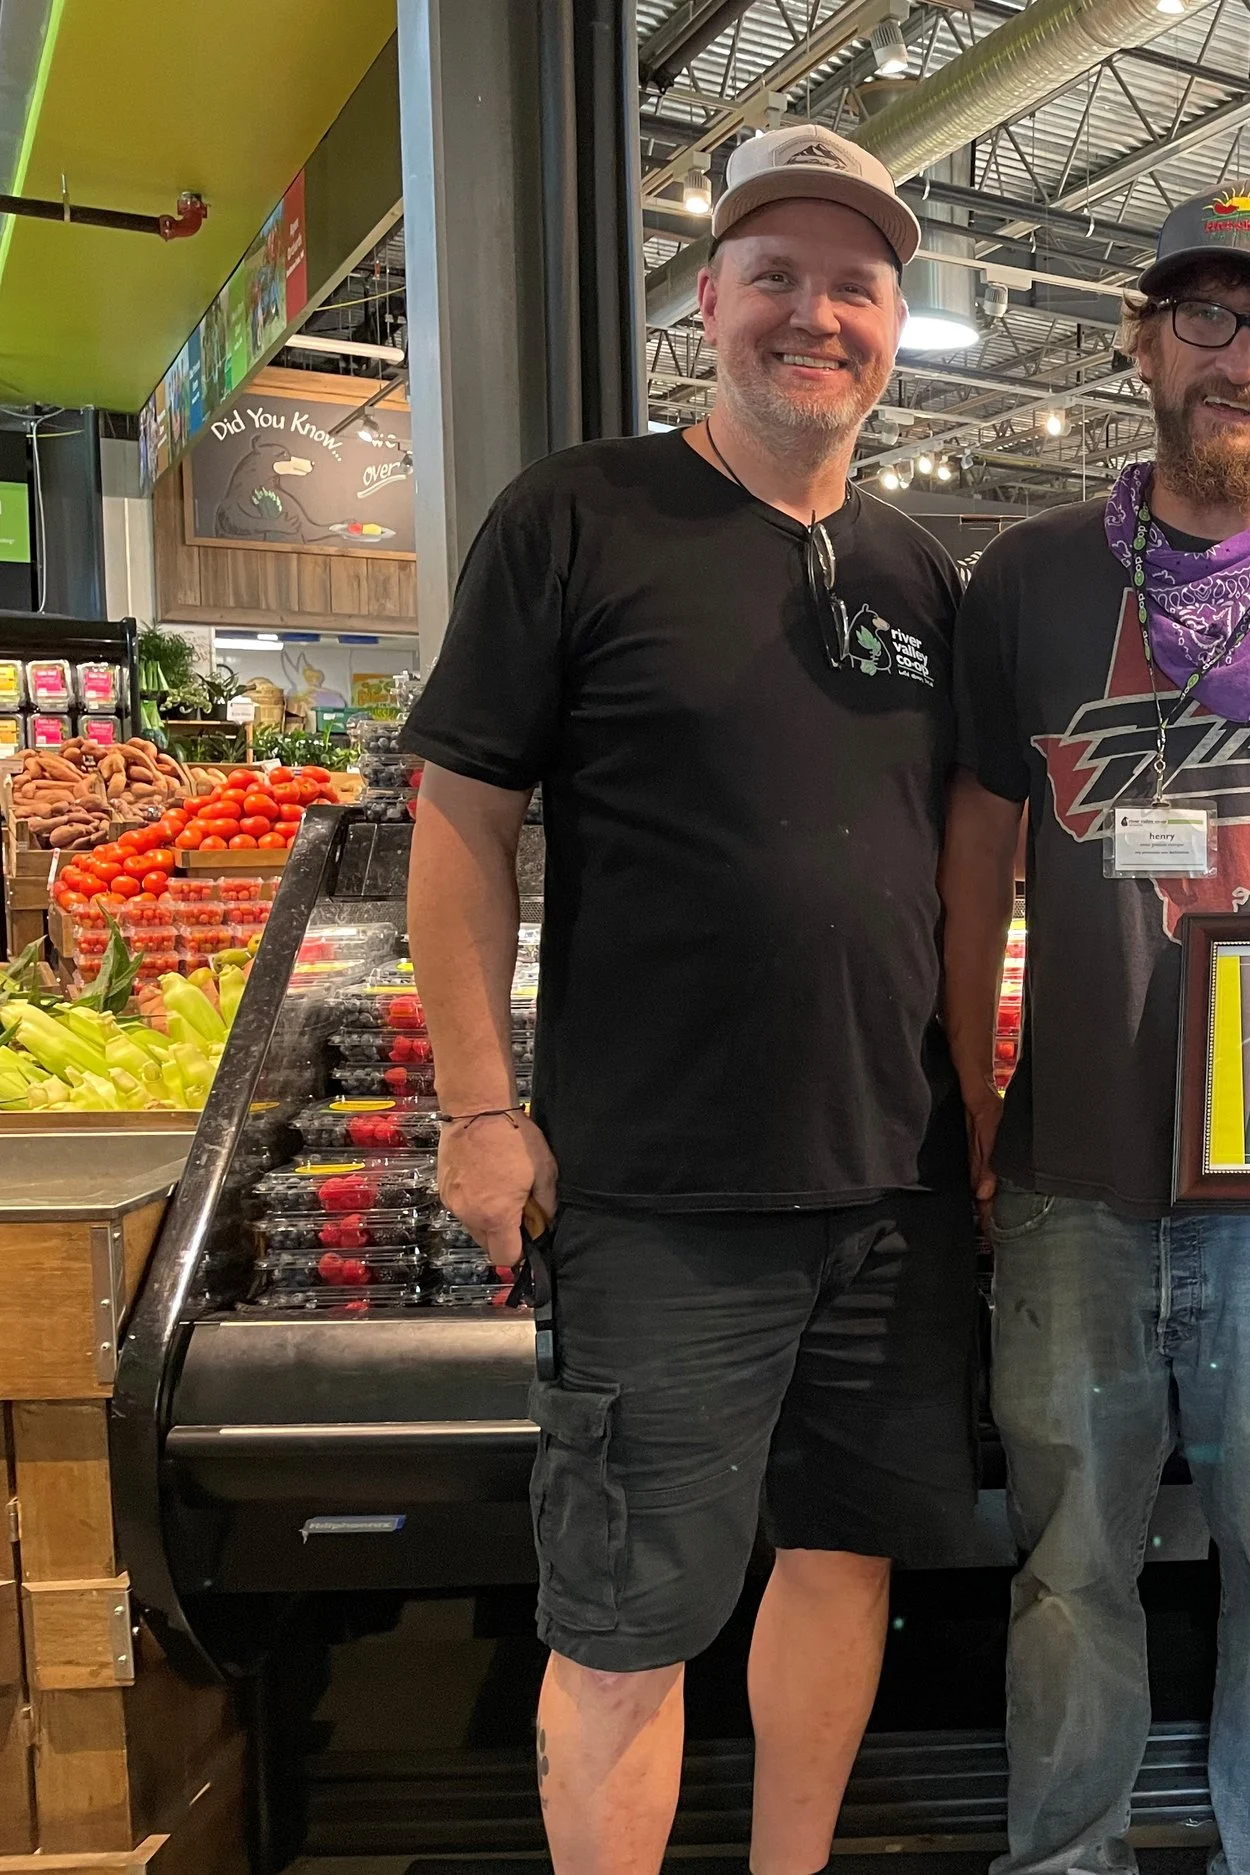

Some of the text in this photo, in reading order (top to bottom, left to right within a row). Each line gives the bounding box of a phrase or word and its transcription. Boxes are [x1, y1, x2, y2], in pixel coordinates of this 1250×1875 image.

[211, 410, 245, 441] Did
[247, 407, 285, 429] You
[891, 628, 922, 648] river
[892, 641, 928, 667] valley
[896, 654, 929, 675] co-op
[1149, 832, 1175, 841] henry
